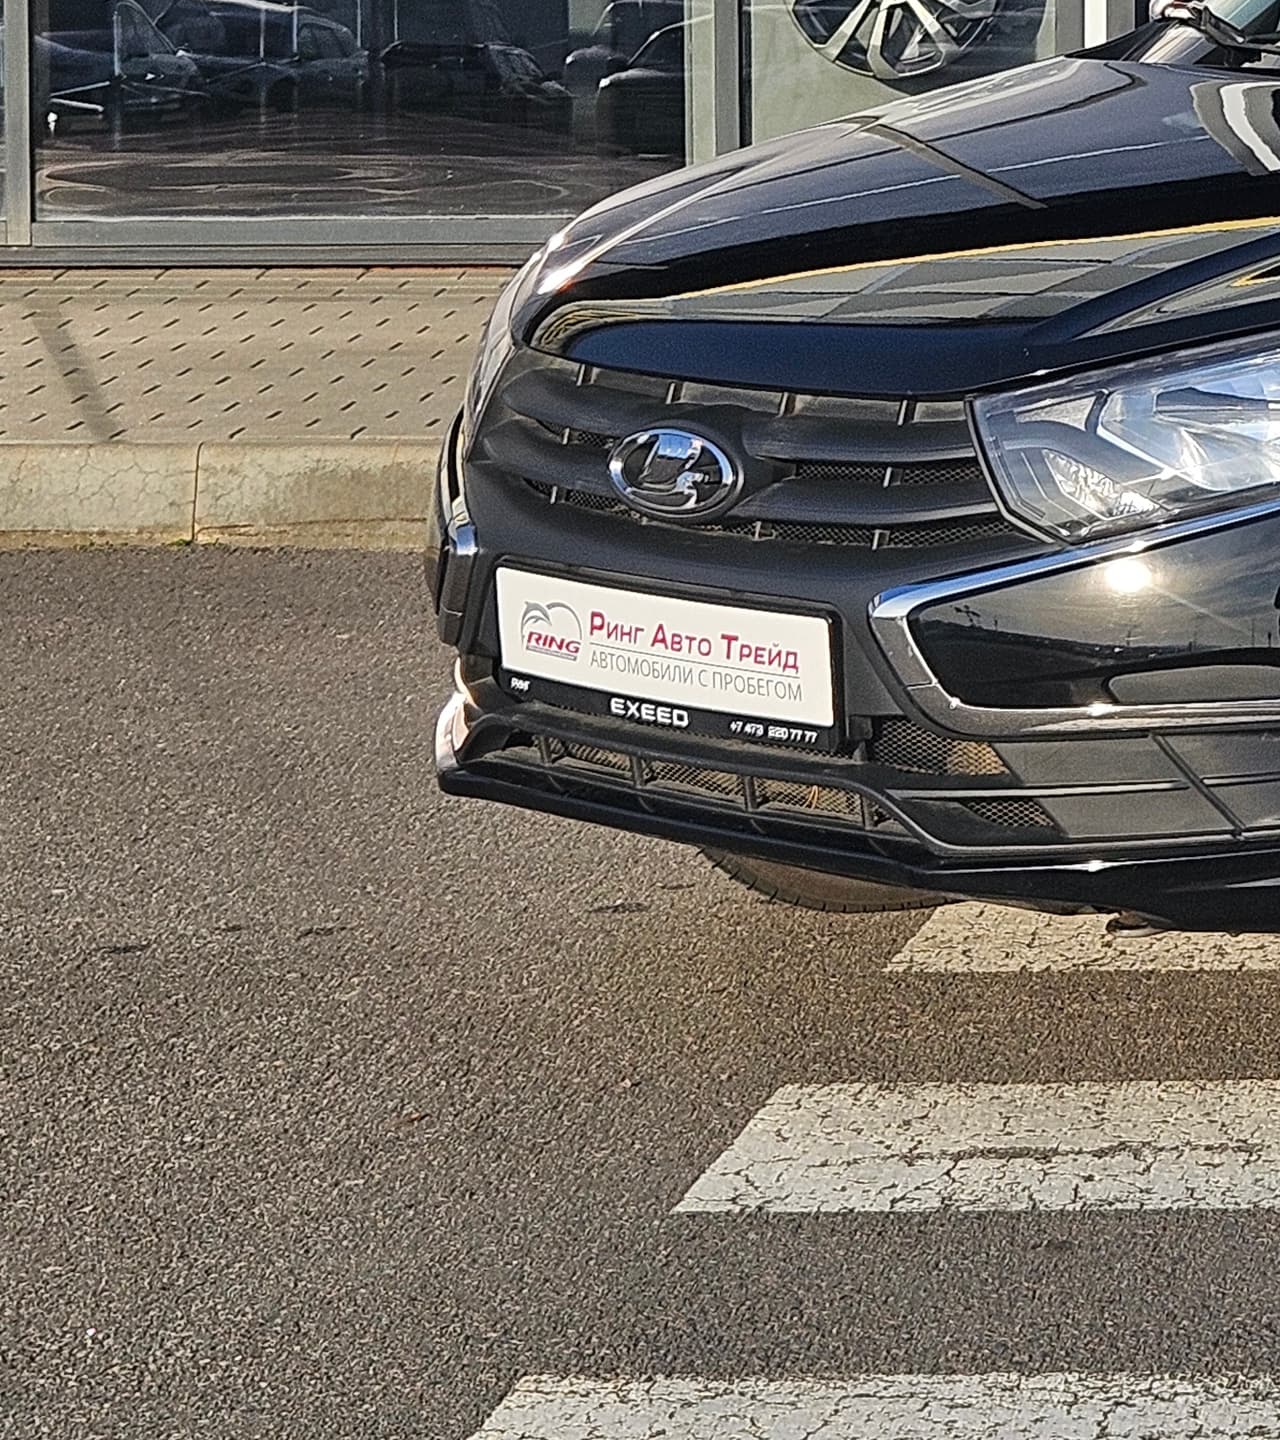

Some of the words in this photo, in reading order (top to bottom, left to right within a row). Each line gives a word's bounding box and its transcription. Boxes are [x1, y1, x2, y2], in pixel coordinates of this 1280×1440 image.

[527, 631, 581, 654] RING
[590, 650, 694, 685] АВТОМОБИЛИ
[698, 669, 708, 687] С
[712, 671, 802, 701] ПРОБЕГОМ
[610, 697, 689, 728] EXEED
